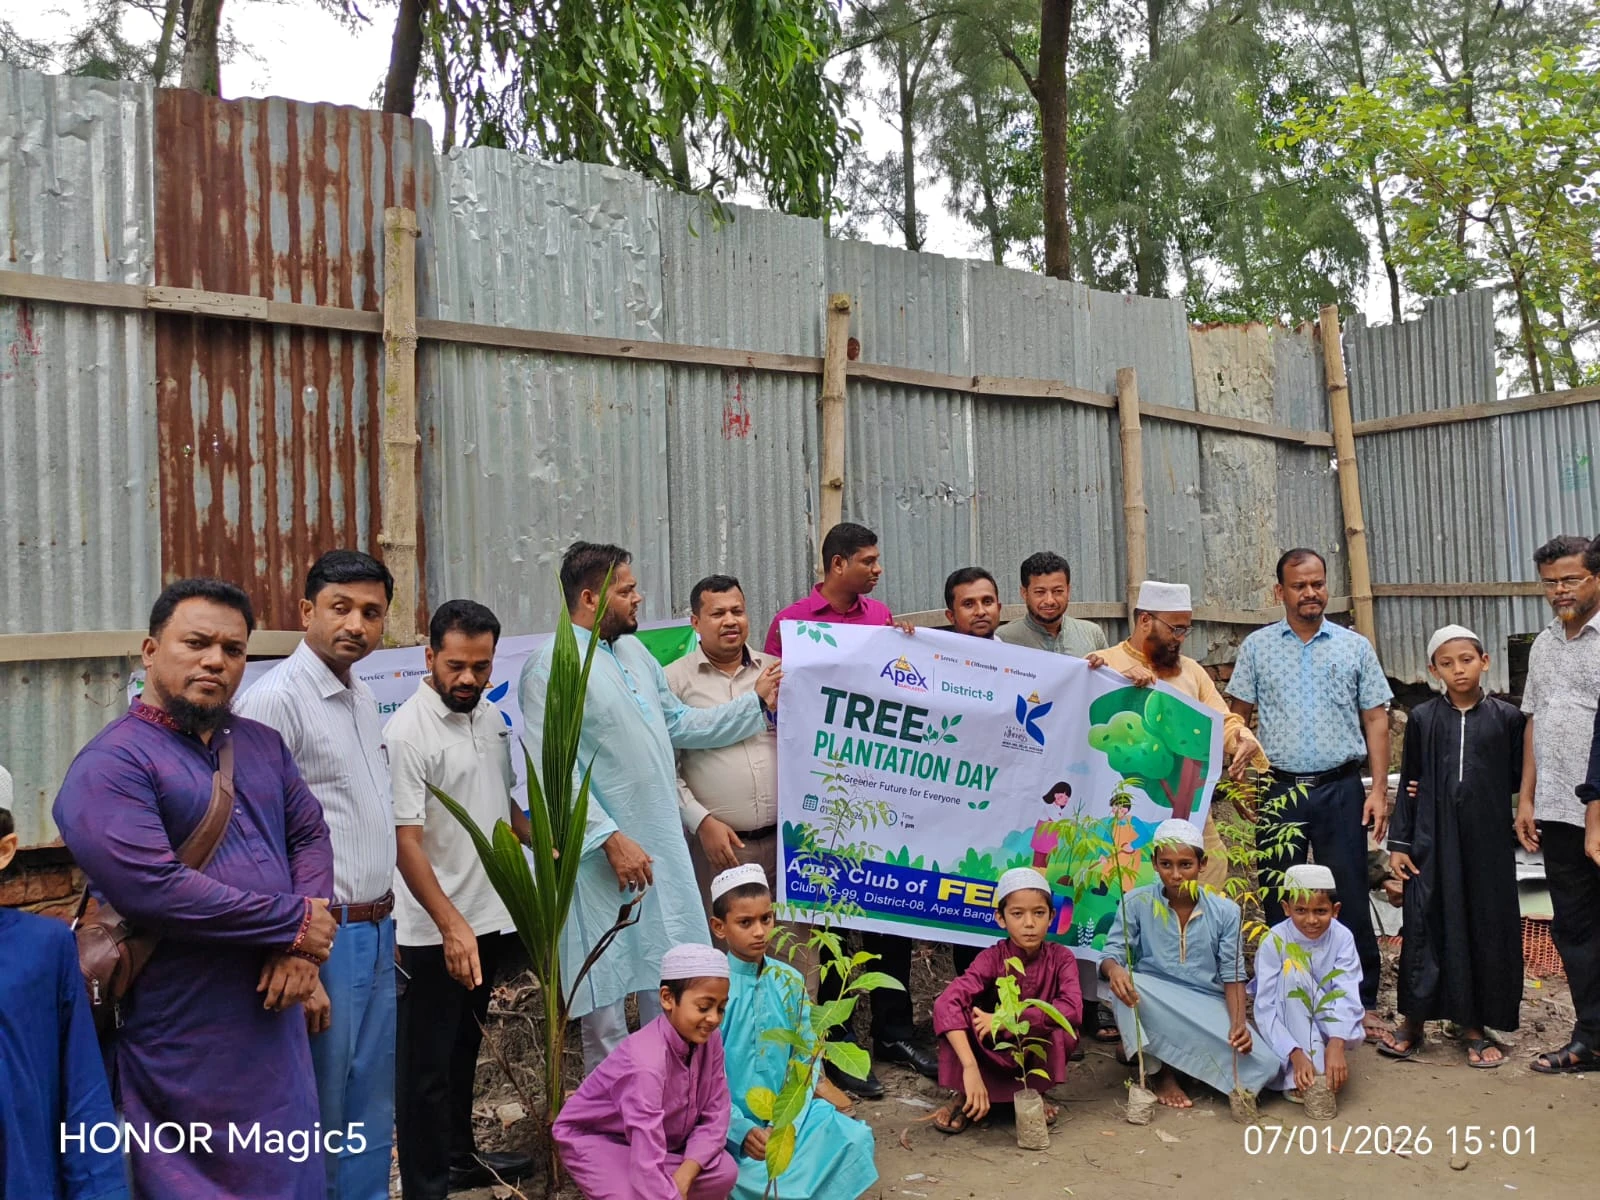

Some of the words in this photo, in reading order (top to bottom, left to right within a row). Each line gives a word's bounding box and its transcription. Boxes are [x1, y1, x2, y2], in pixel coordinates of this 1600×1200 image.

[880, 659, 928, 690] Apex
[941, 680, 994, 702] District-8
[820, 686, 929, 744] TREE
[813, 729, 951, 784] PLANTATION
[955, 759, 999, 793] DAY
[844, 774, 877, 789] Greener
[880, 781, 908, 795] Future
[910, 787, 921, 797] for
[923, 790, 961, 806] Everyone
[848, 867, 899, 890] Club
[905, 880, 928, 895] of
[790, 880, 816, 894] Club
[864, 891, 927, 913] District-08,
[930, 903, 960, 917] Apex
